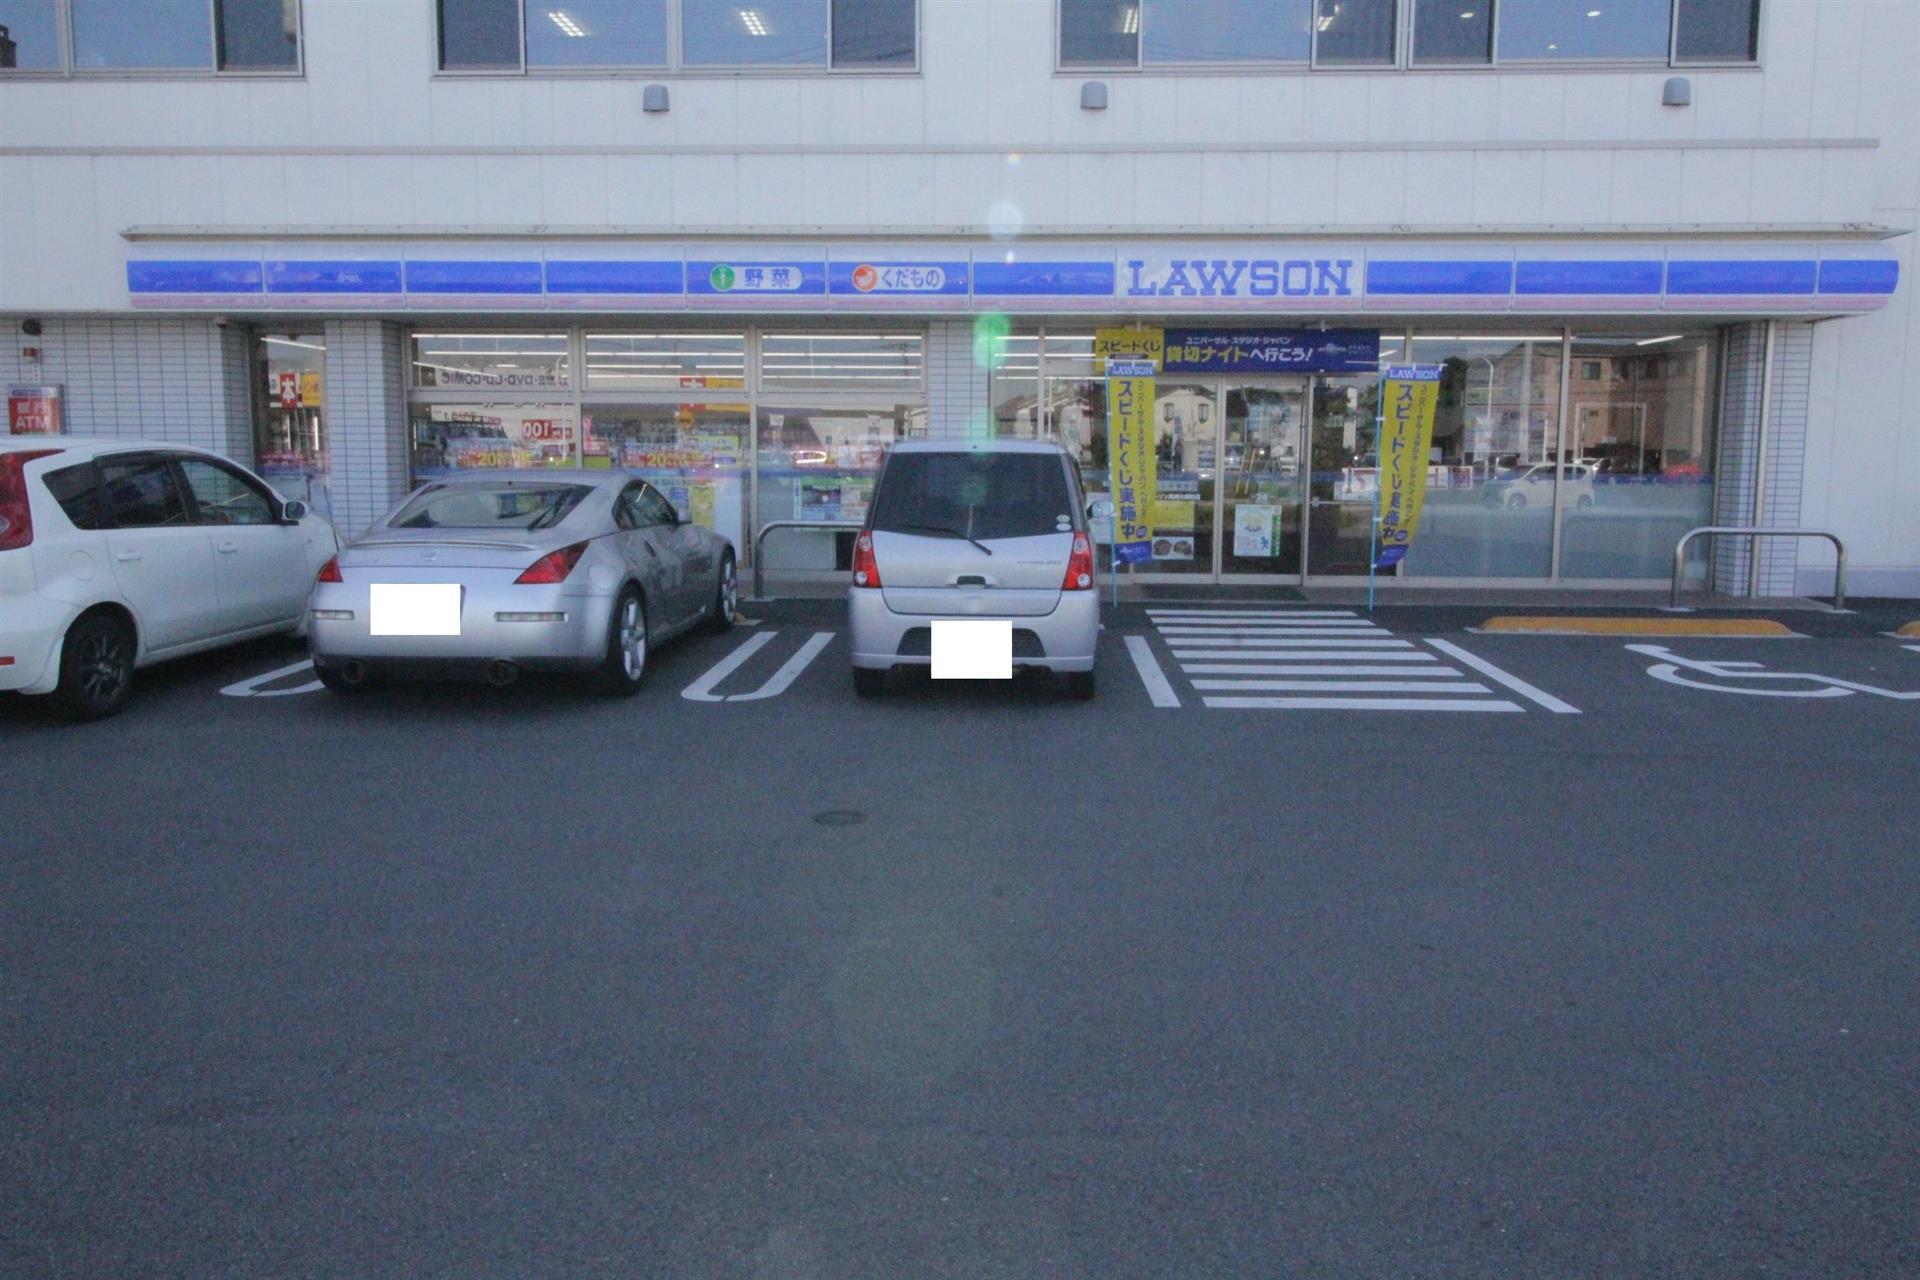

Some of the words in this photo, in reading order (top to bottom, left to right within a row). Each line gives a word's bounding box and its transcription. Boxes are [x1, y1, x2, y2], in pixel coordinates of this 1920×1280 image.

[744, 268, 790, 288] 野菜
[881, 269, 940, 287] くだもの
[1128, 260, 1352, 296] LAWSON
[1099, 339, 1161, 352] スピードくじ
[1111, 365, 1154, 376] LAWSON
[1389, 368, 1439, 380] LAWSON
[16, 415, 50, 429] ATM
[1117, 380, 1137, 540] スピードくじ実施中
